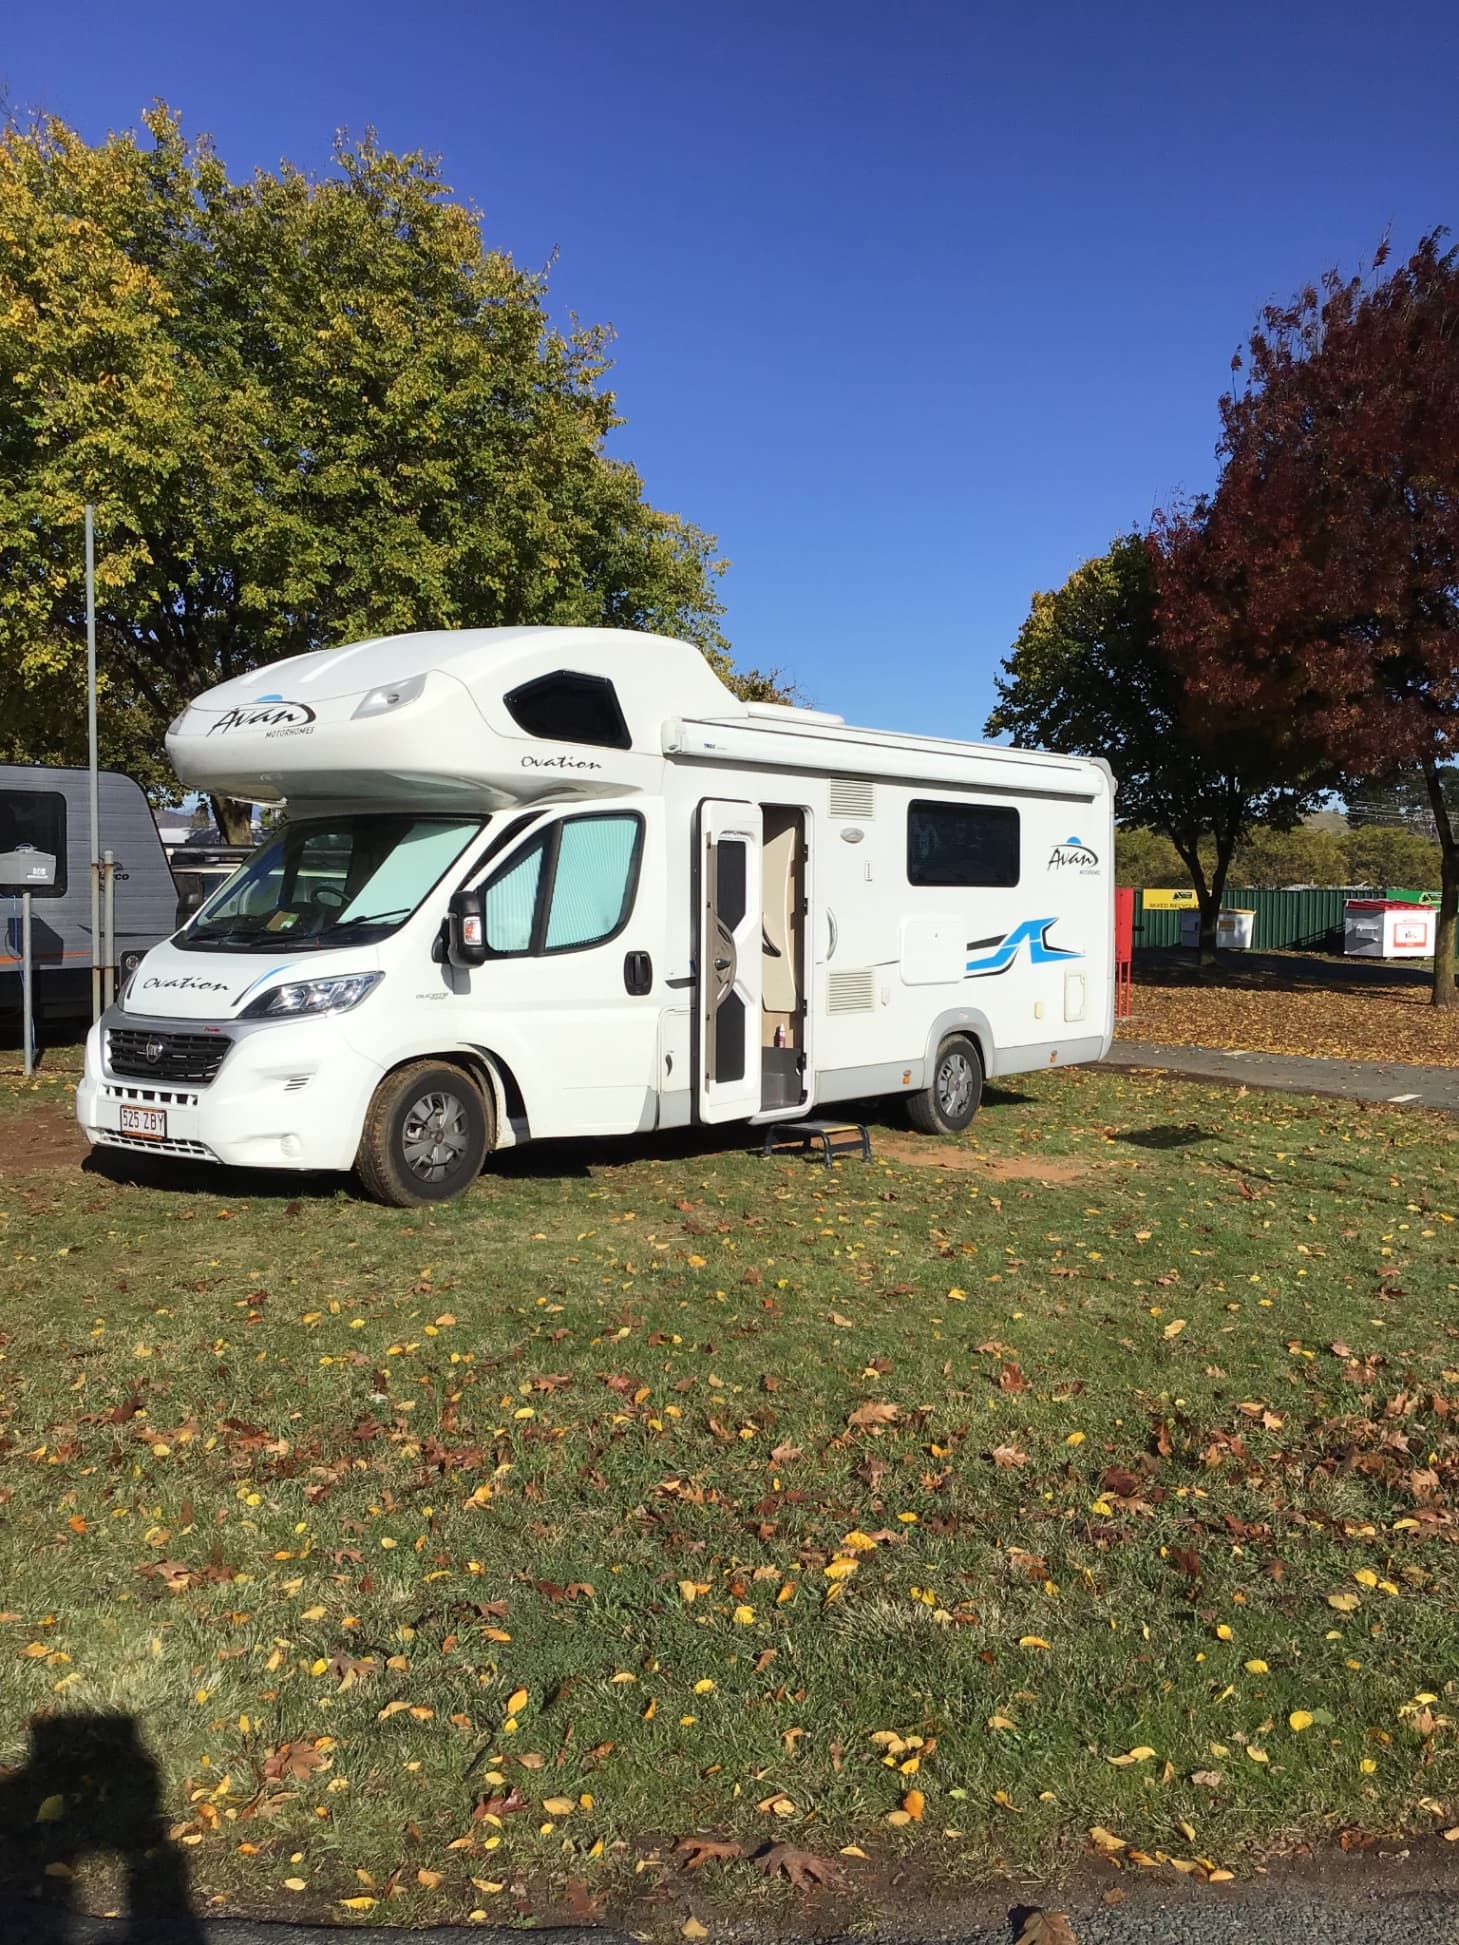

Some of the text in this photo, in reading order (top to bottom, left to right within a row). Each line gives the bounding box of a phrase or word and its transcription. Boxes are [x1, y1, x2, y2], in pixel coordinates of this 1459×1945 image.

[206, 706, 298, 737] Avan
[265, 727, 315, 738] MOTORHOMES
[521, 756, 603, 769] Ovation
[1047, 847, 1093, 871] Avan
[143, 977, 230, 991] Ovation
[123, 1110, 164, 1131] 525 ZBY
